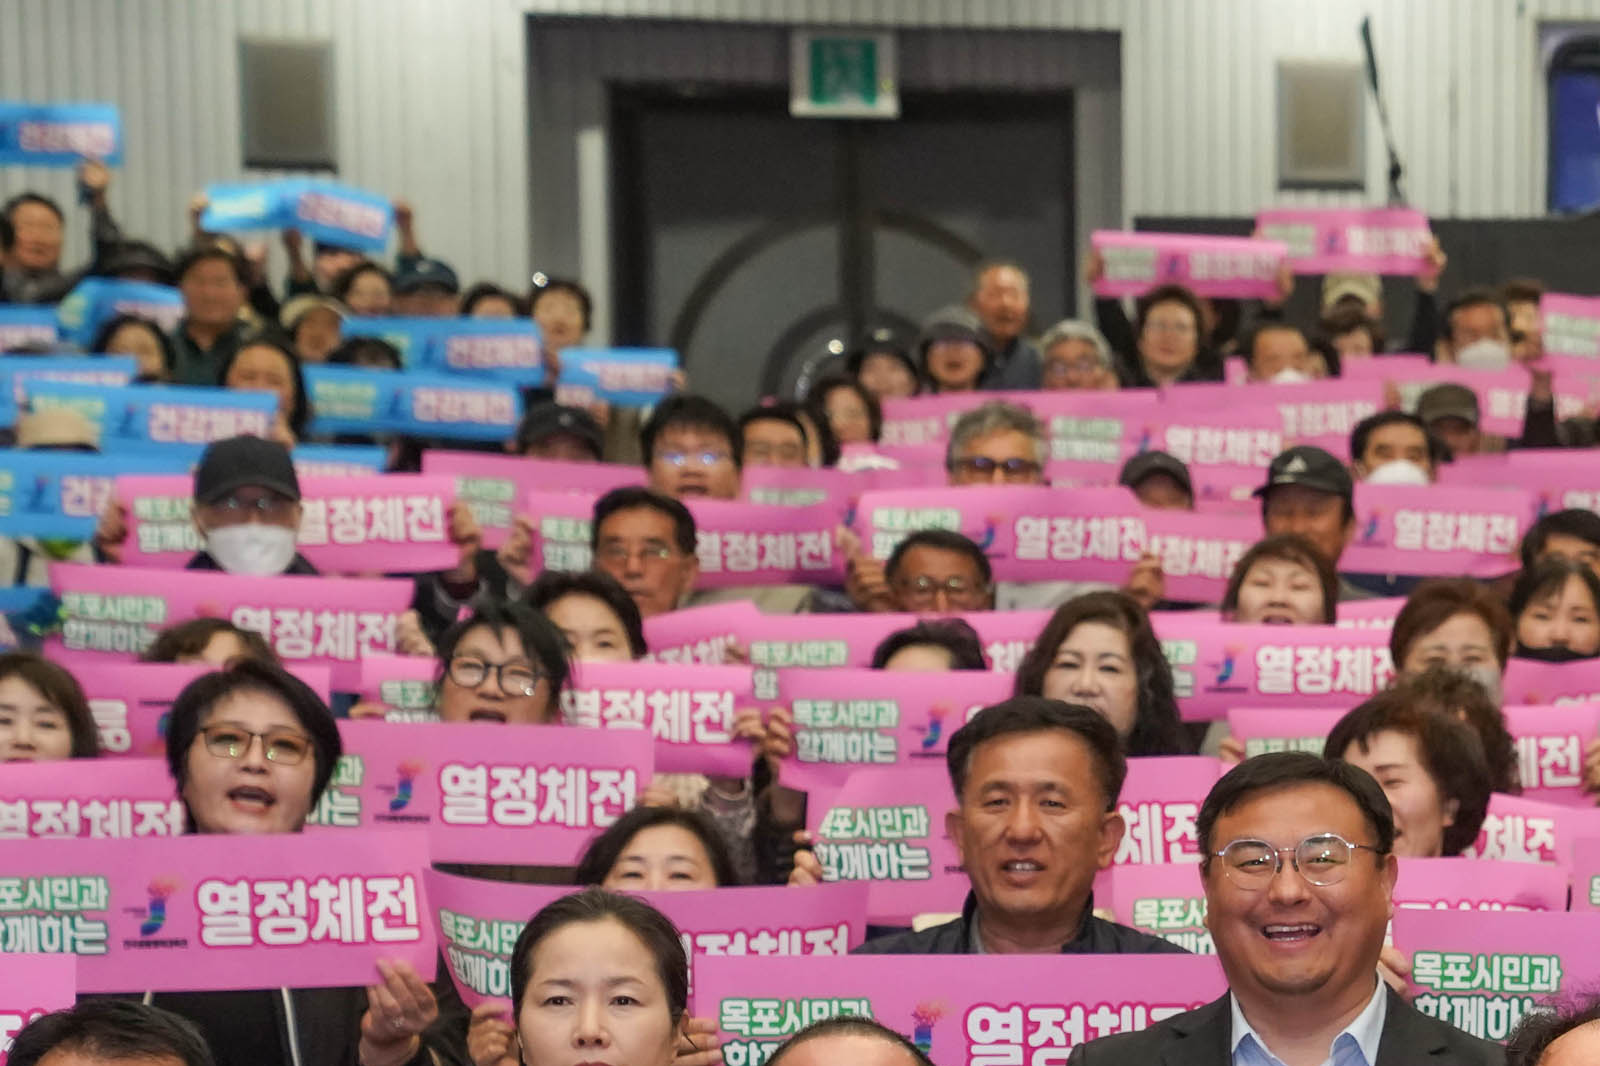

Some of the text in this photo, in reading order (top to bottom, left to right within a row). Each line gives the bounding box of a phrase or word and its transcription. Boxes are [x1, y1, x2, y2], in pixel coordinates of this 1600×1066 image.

[792, 700, 899, 731] 목포시민과
[438, 762, 638, 828] 열정체전
[0, 875, 110, 911] 포시민과
[196, 874, 421, 948] 열정체전
[1412, 950, 1562, 994] 목포시민과
